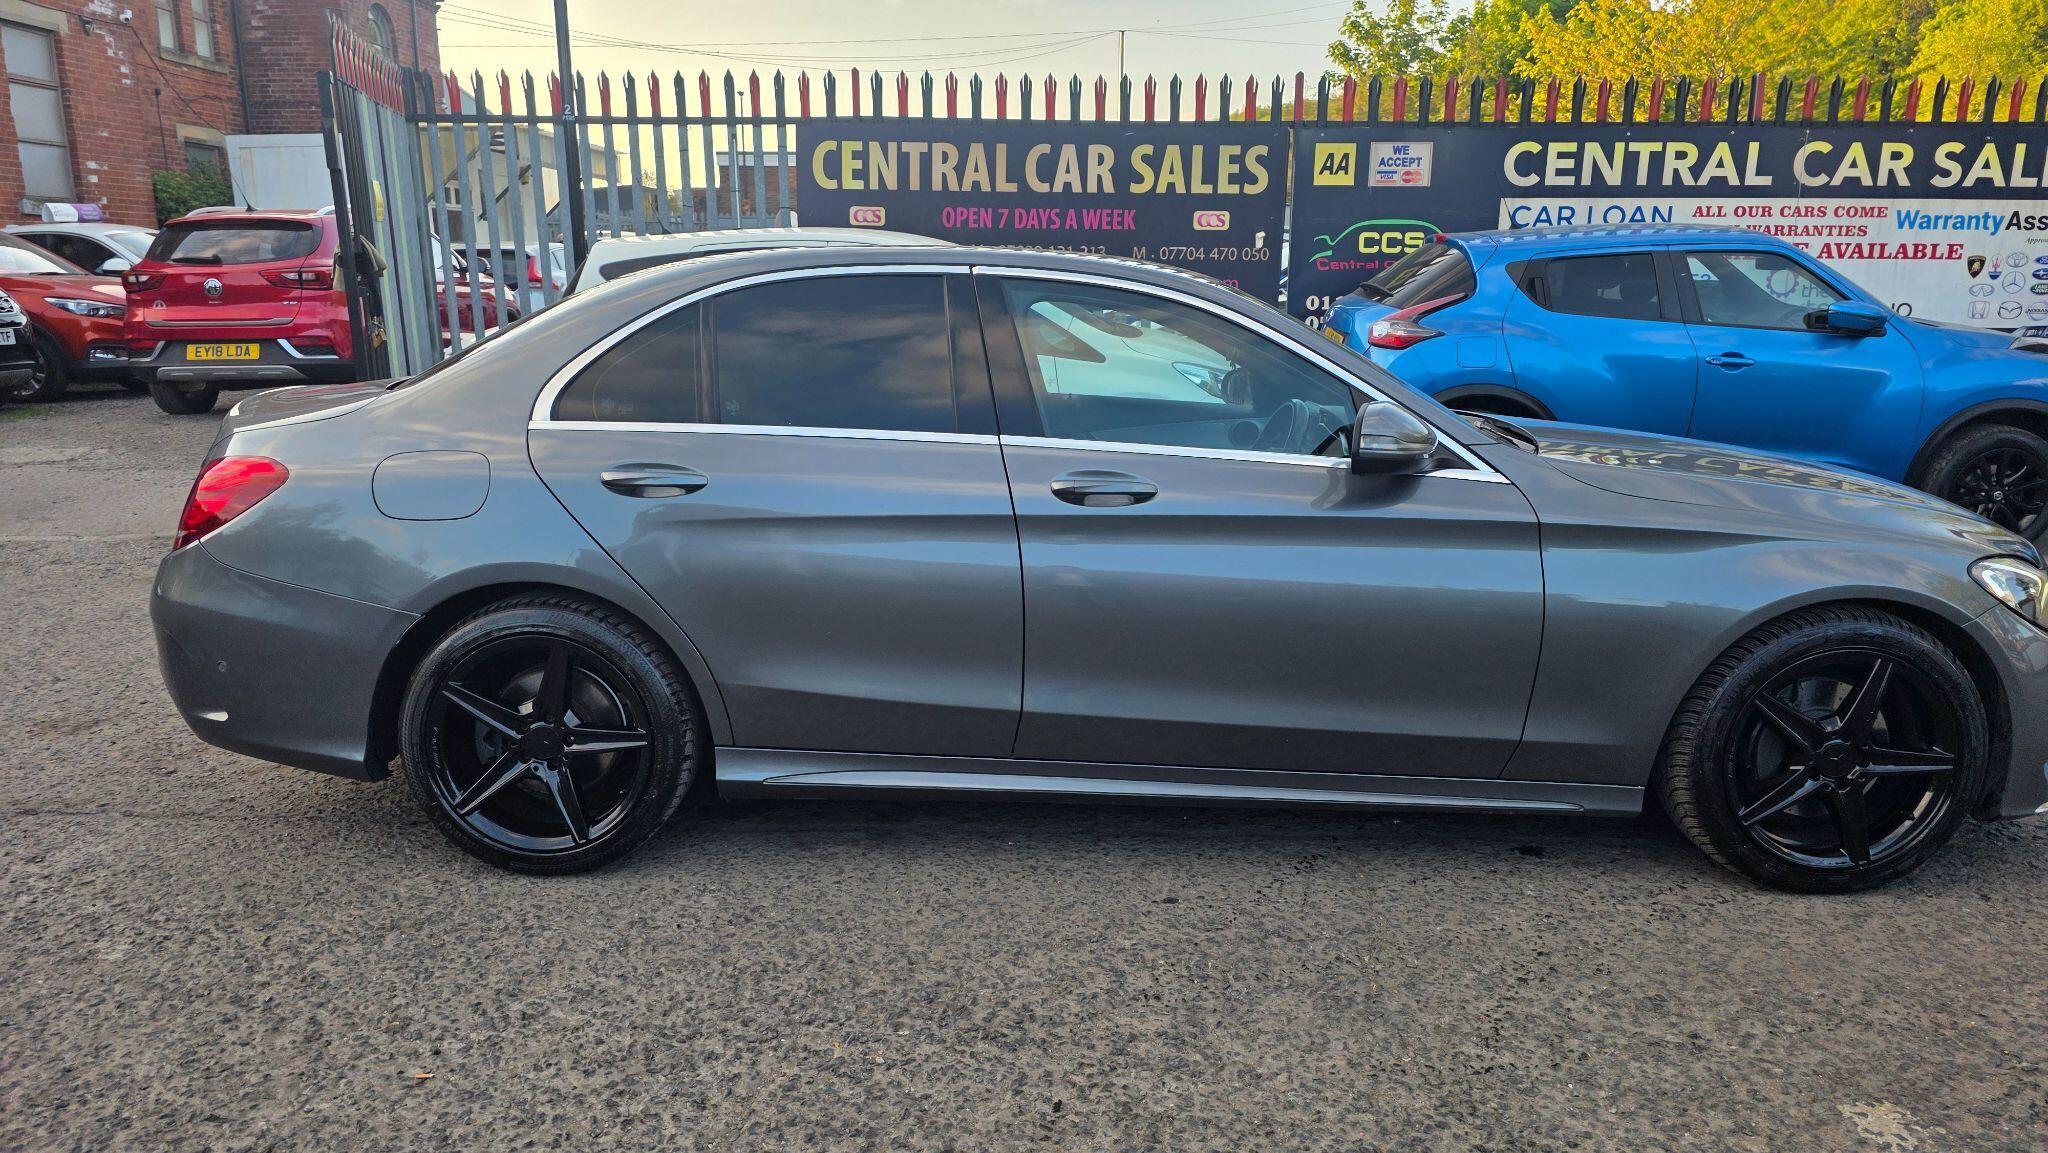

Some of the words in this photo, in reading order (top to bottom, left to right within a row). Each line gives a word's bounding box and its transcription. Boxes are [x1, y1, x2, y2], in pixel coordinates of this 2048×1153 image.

[1392, 145, 1410, 156] WE
[812, 140, 1018, 193] CENTRAL
[1025, 143, 1115, 194] CAR
[1129, 144, 1270, 196] SALES
[1318, 152, 1350, 176] AA
[1377, 156, 1423, 168] ACCEPT
[1503, 140, 1773, 187] CENTRAL
[1793, 140, 1915, 187] CAR
[1929, 141, 2048, 188] SAL
[853, 209, 882, 224] CCS
[942, 206, 992, 229] OPEN
[998, 208, 1009, 230] 7
[1014, 208, 1062, 231] DAYS
[1065, 209, 1081, 231] A
[1081, 210, 1136, 232] WEEK
[1511, 205, 1576, 229] CAR
[1692, 205, 1727, 218] ALL
[1733, 205, 1774, 218] OUR
[1779, 205, 1828, 218] CARS
[1833, 205, 1889, 218] COME
[1197, 213, 1227, 229] CCS
[1358, 231, 1426, 254] CCS
[1160, 246, 1206, 261] 07704
[1209, 246, 1238, 261] 470
[1241, 247, 1270, 261] 050
[1817, 242, 1964, 260] AVAILABLE
[1316, 257, 1379, 271] Central
[194, 345, 223, 358] EY18
[226, 345, 251, 357] LDA
